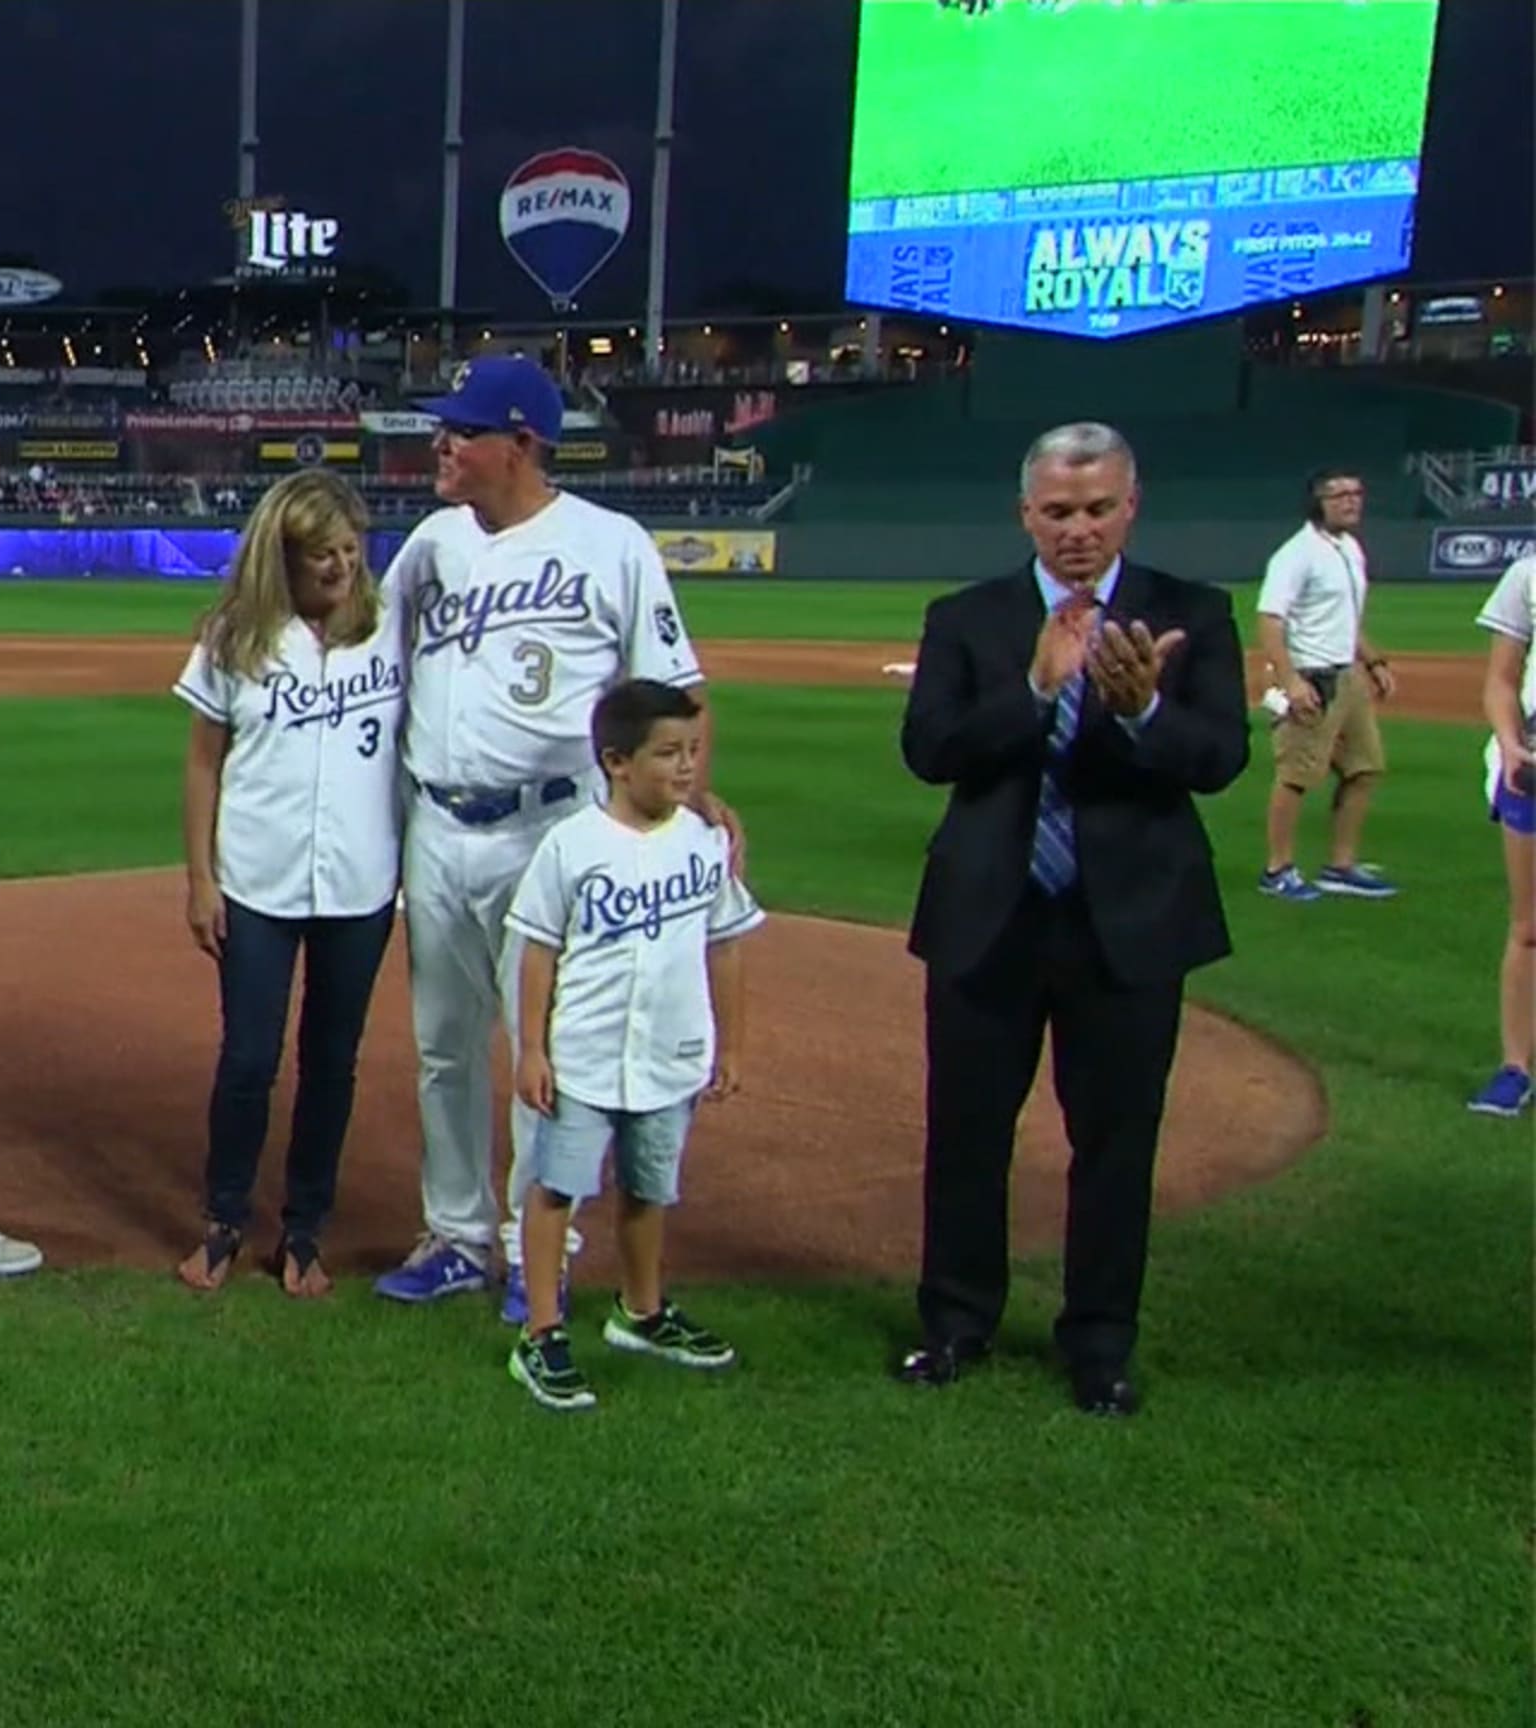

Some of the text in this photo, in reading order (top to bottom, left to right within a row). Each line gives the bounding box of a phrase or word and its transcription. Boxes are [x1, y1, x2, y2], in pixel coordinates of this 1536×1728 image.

[517, 186, 614, 217] RE/MAX
[248, 208, 338, 269] Lite
[1031, 219, 1210, 272] ALWAYS
[1025, 265, 1166, 313] ROYAL
[415, 558, 592, 656] Royals
[265, 656, 406, 728] Royals
[509, 642, 555, 706] 3
[357, 717, 382, 758] 3
[576, 853, 724, 943] Royals
